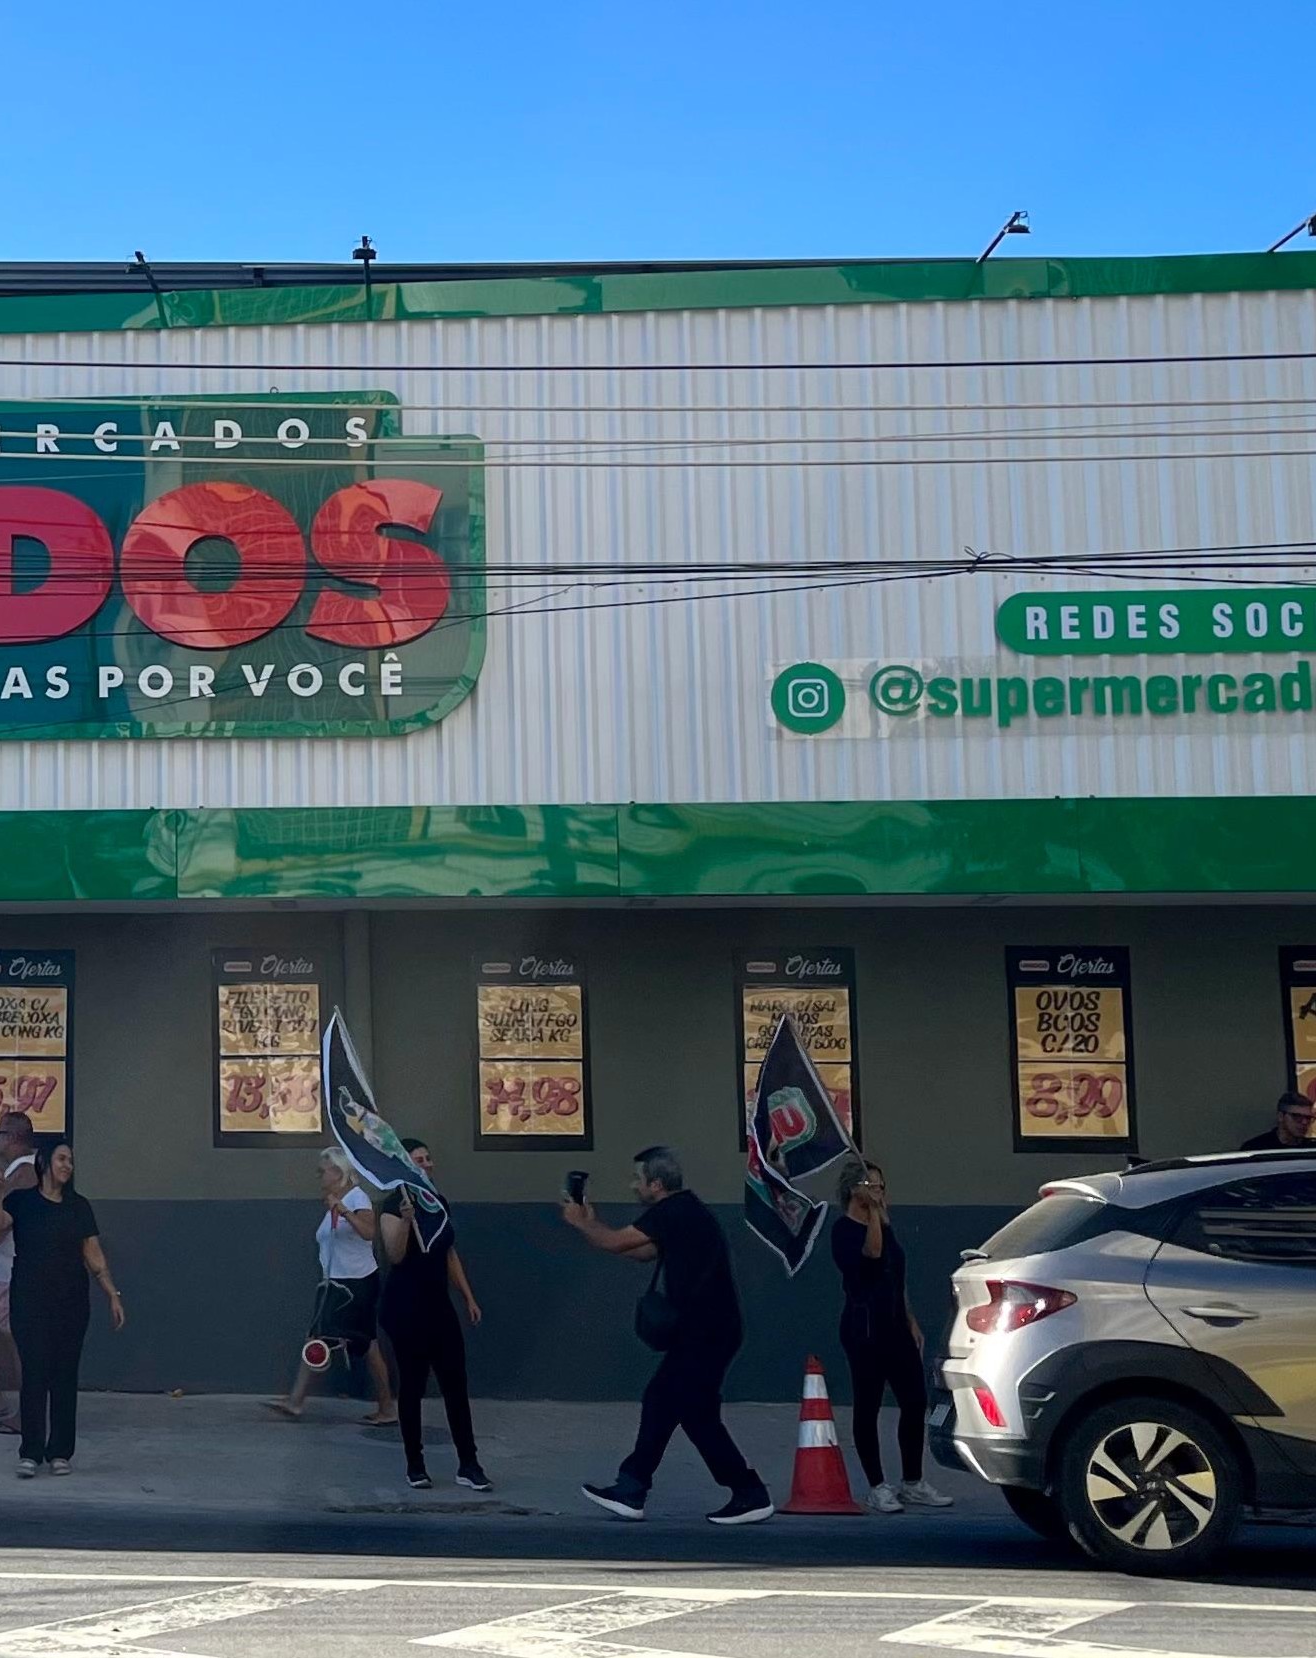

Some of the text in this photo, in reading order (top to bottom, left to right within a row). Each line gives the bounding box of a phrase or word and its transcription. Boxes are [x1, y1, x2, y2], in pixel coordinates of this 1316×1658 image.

[1026, 603, 1180, 640] REDES
[98, 664, 217, 699] POR
[241, 652, 403, 697] VOCÊ
[8, 957, 63, 979] Ofertas
[260, 955, 314, 977] Ofertas
[519, 956, 574, 979] Ofertas
[785, 955, 843, 978] Ofertas
[1057, 953, 1116, 977] Ofertas
[1036, 991, 1101, 1011] OVOS
[44, 1026, 64, 1039] KG
[1037, 1012, 1101, 1033] BCOS
[548, 1028, 571, 1043] KG
[1072, 1034, 1100, 1053] 20
